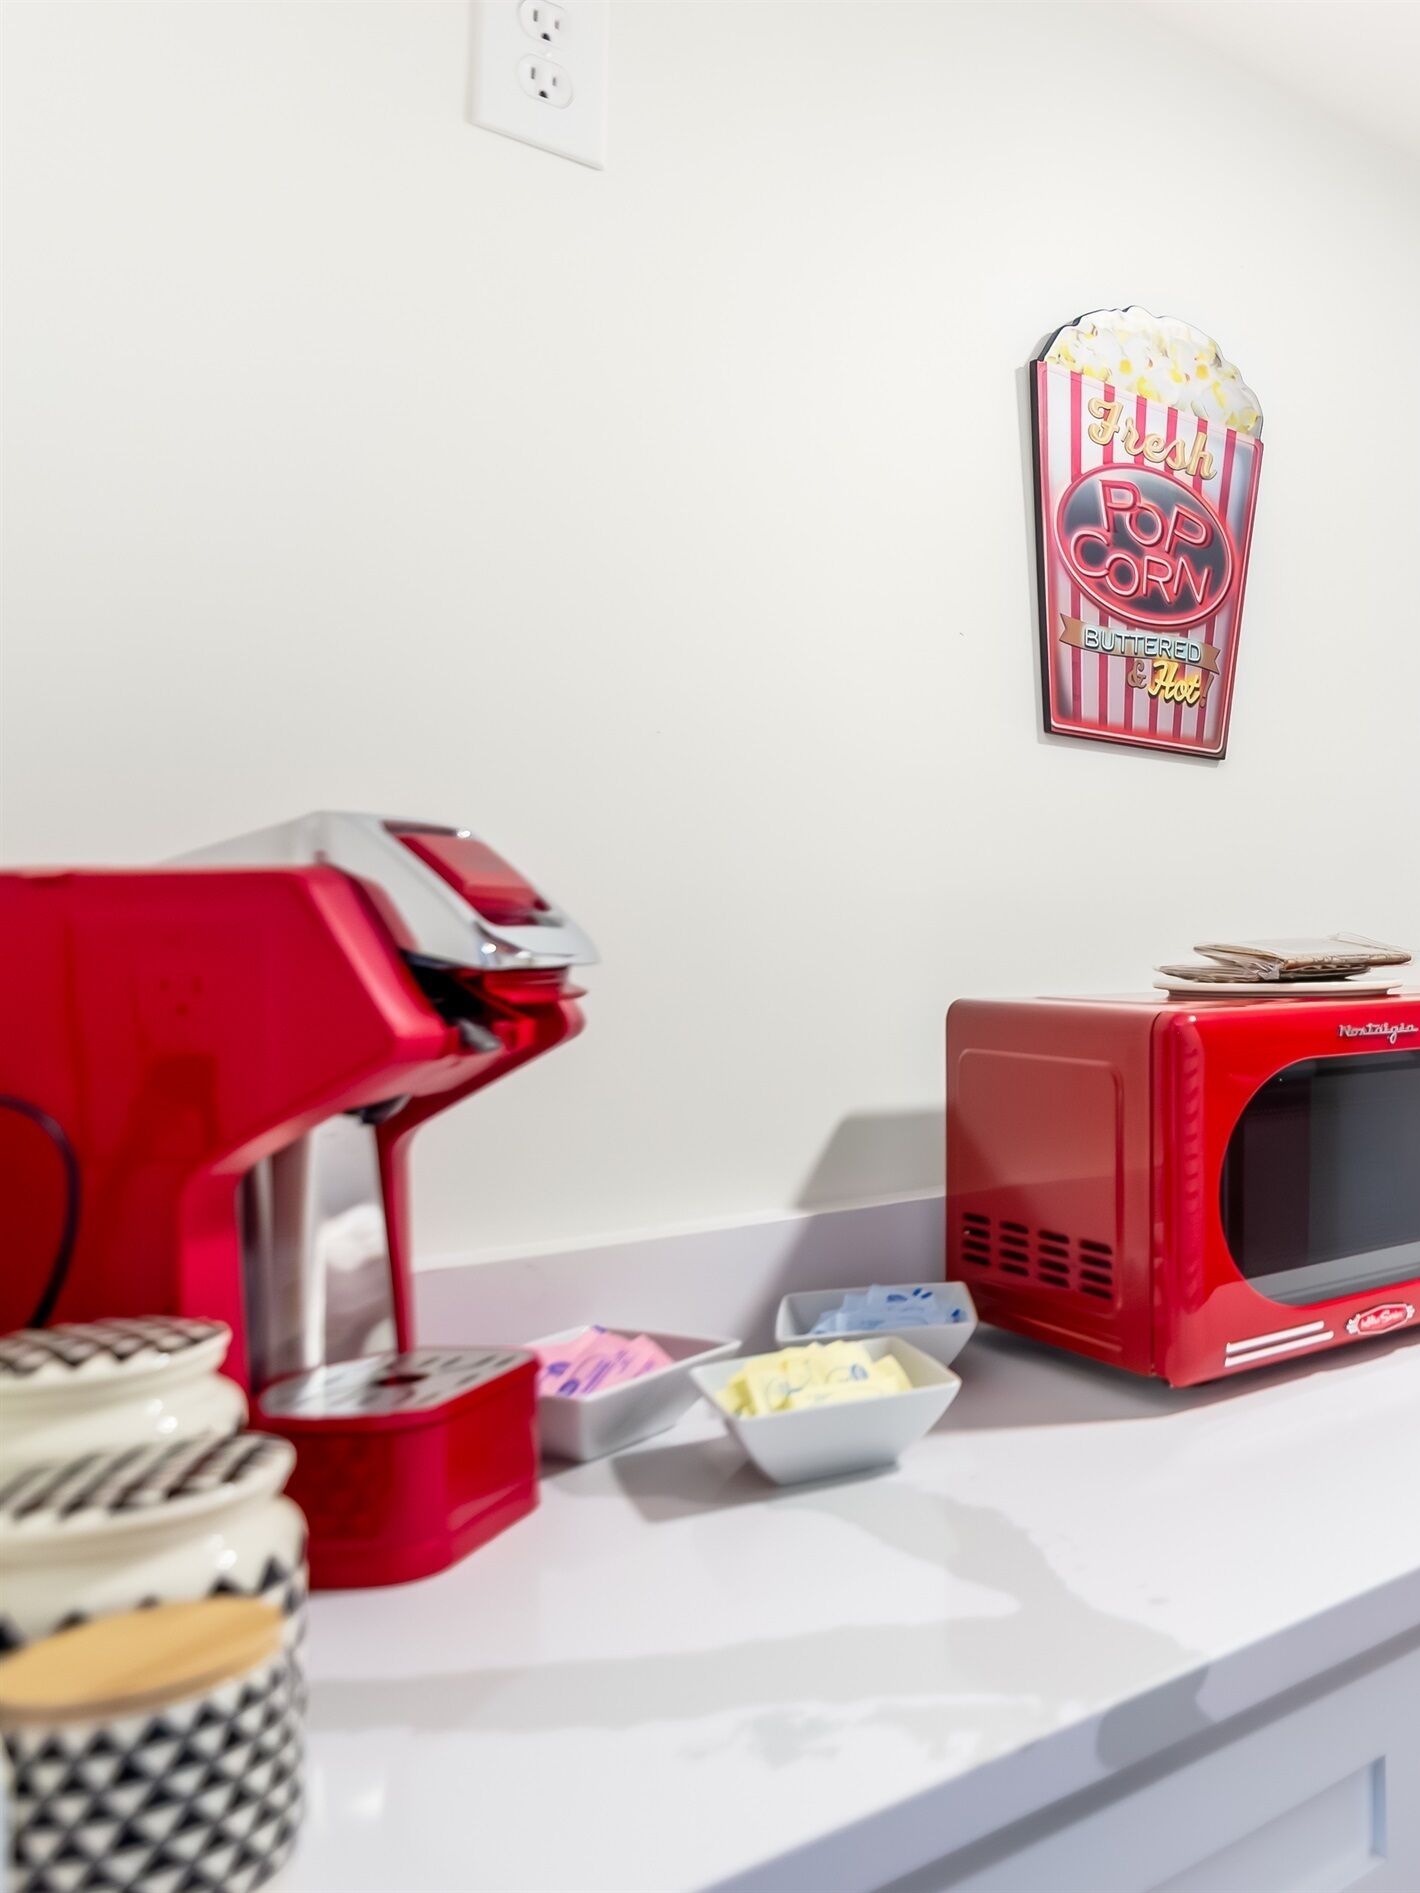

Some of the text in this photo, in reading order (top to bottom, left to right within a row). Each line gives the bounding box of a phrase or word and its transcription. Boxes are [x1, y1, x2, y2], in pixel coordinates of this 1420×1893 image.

[1088, 397, 1217, 480] Fresh
[1099, 478, 1213, 556] POP
[1069, 529, 1209, 605] CORN
[1084, 627, 1202, 663] BUTTERED
[1127, 659, 1147, 689] &
[1338, 1022, 1419, 1045] Nostalgia
